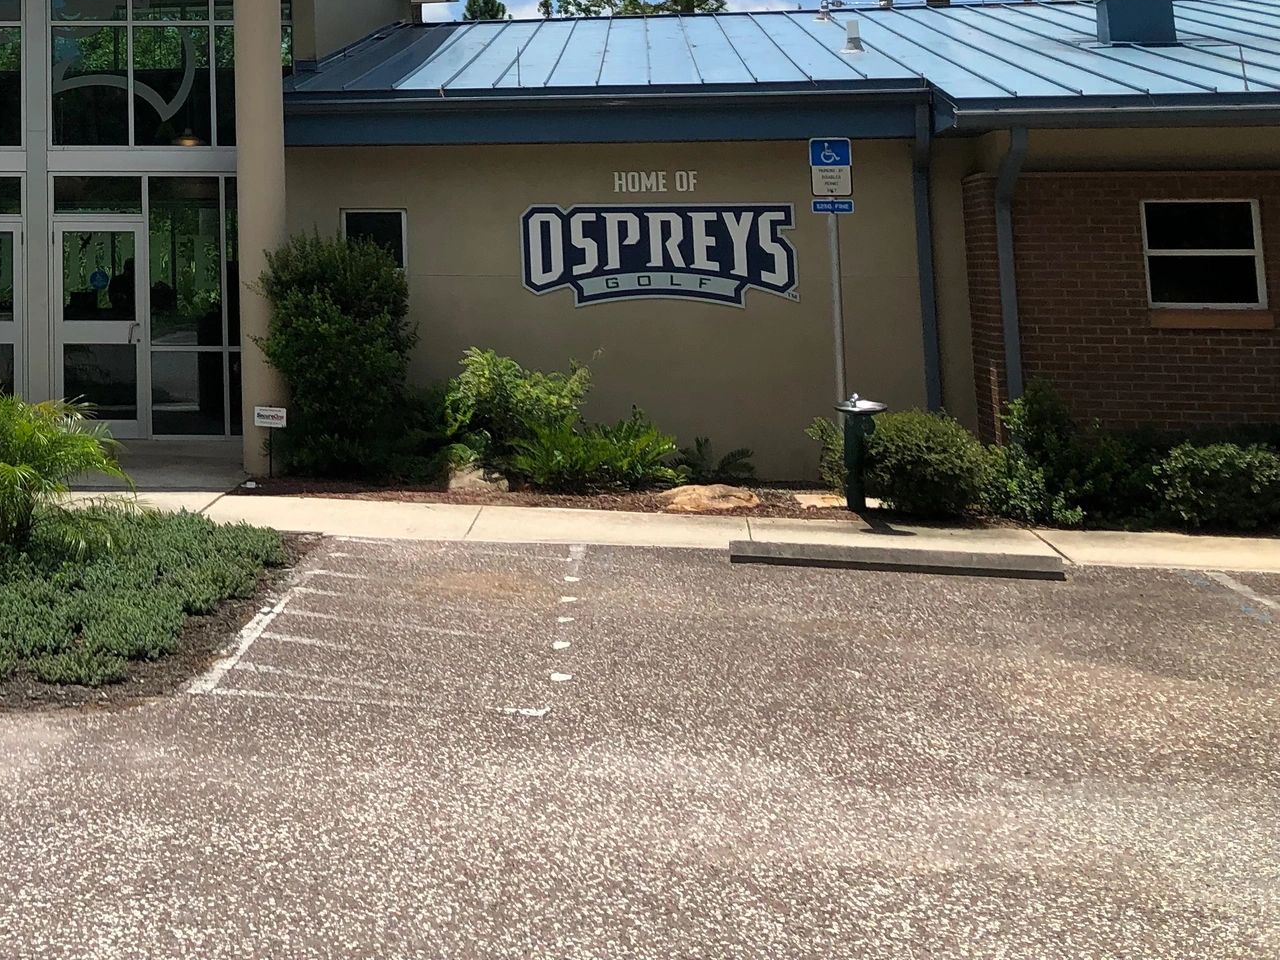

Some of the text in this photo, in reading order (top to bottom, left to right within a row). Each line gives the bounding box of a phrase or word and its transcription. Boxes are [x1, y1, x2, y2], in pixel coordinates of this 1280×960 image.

[613, 171, 698, 192] HOME OF
[528, 211, 790, 288] OSPREYS
[605, 275, 712, 290] GOLF
